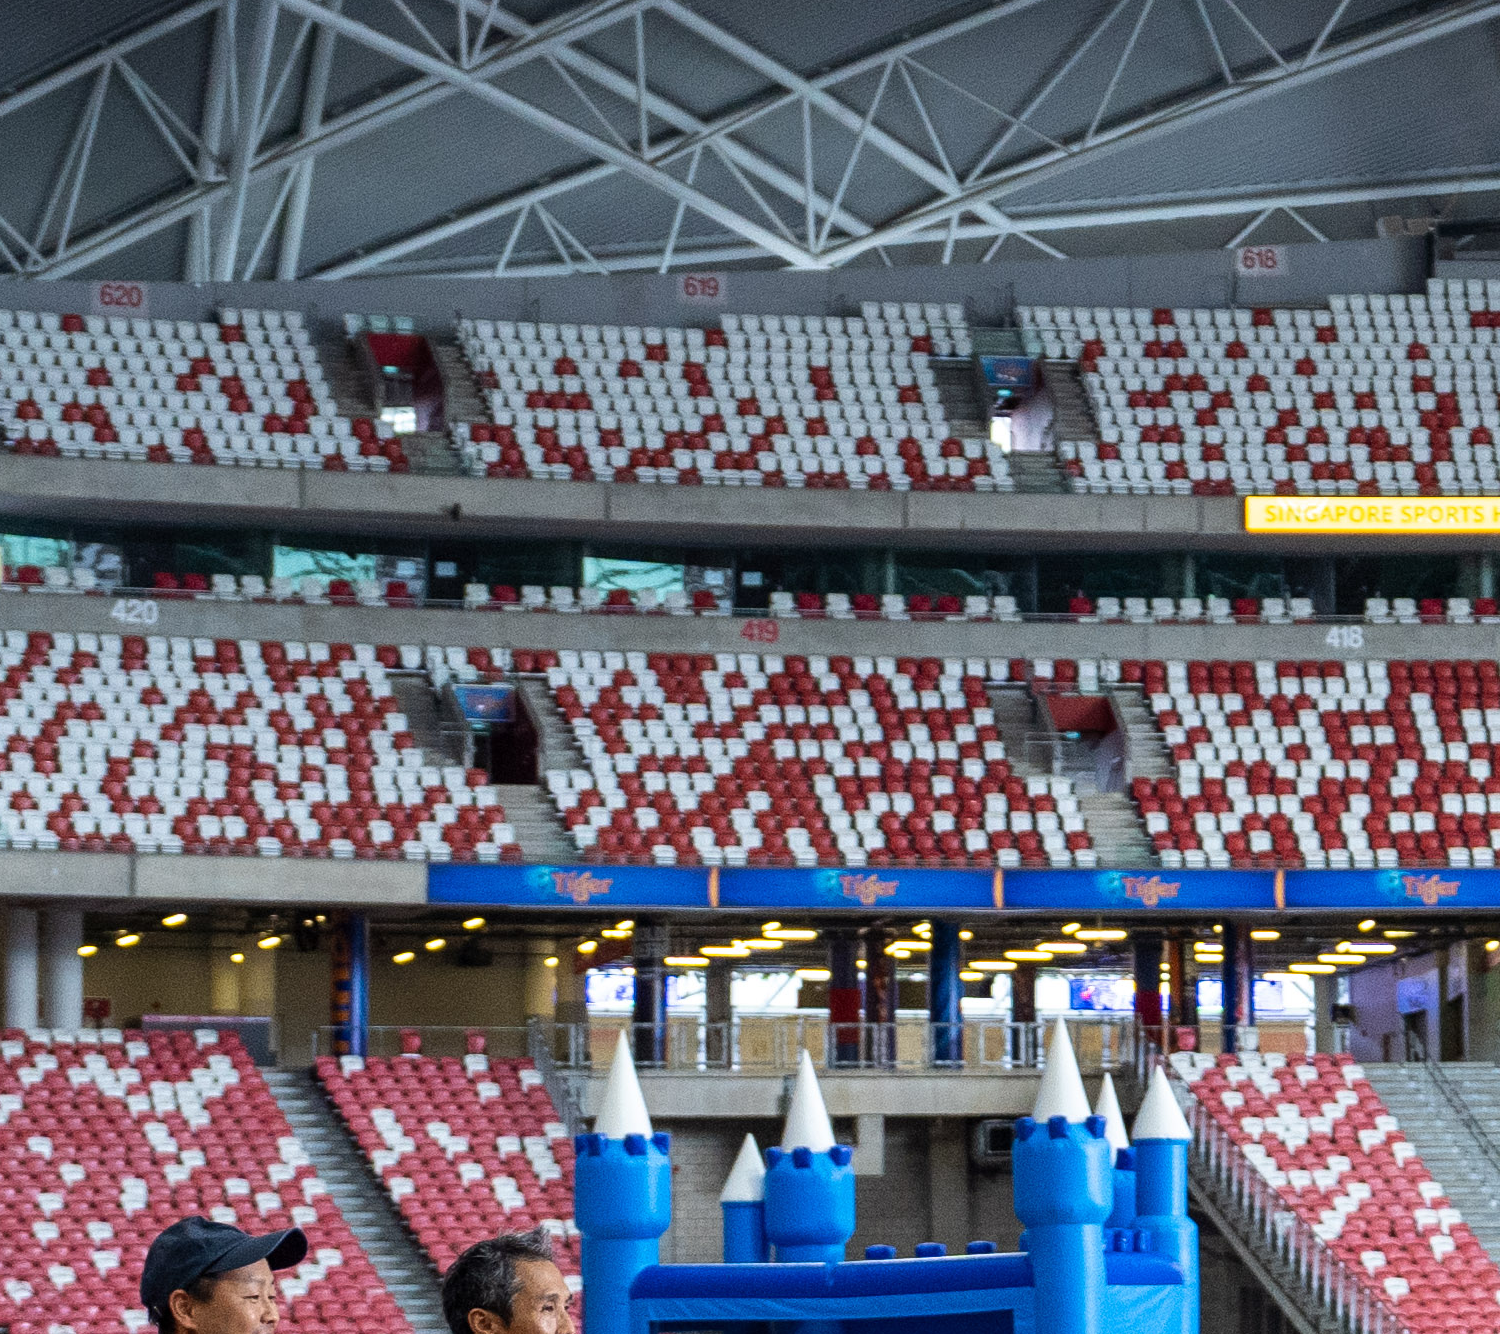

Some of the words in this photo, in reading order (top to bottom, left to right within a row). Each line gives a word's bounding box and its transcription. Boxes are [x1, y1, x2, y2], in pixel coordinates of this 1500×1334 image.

[1242, 247, 1277, 269] 618
[99, 284, 143, 307] 620
[683, 276, 719, 297] 619
[1265, 505, 1392, 524] SINGAPORE
[1400, 505, 1485, 523] SPORTS
[111, 597, 159, 624] 420
[741, 618, 779, 643] 419
[1326, 625, 1364, 648] 418
[551, 871, 614, 904] Tiger
[839, 873, 900, 906] Tiger
[1121, 875, 1182, 908] Tiger
[1402, 874, 1462, 907] Tiger
